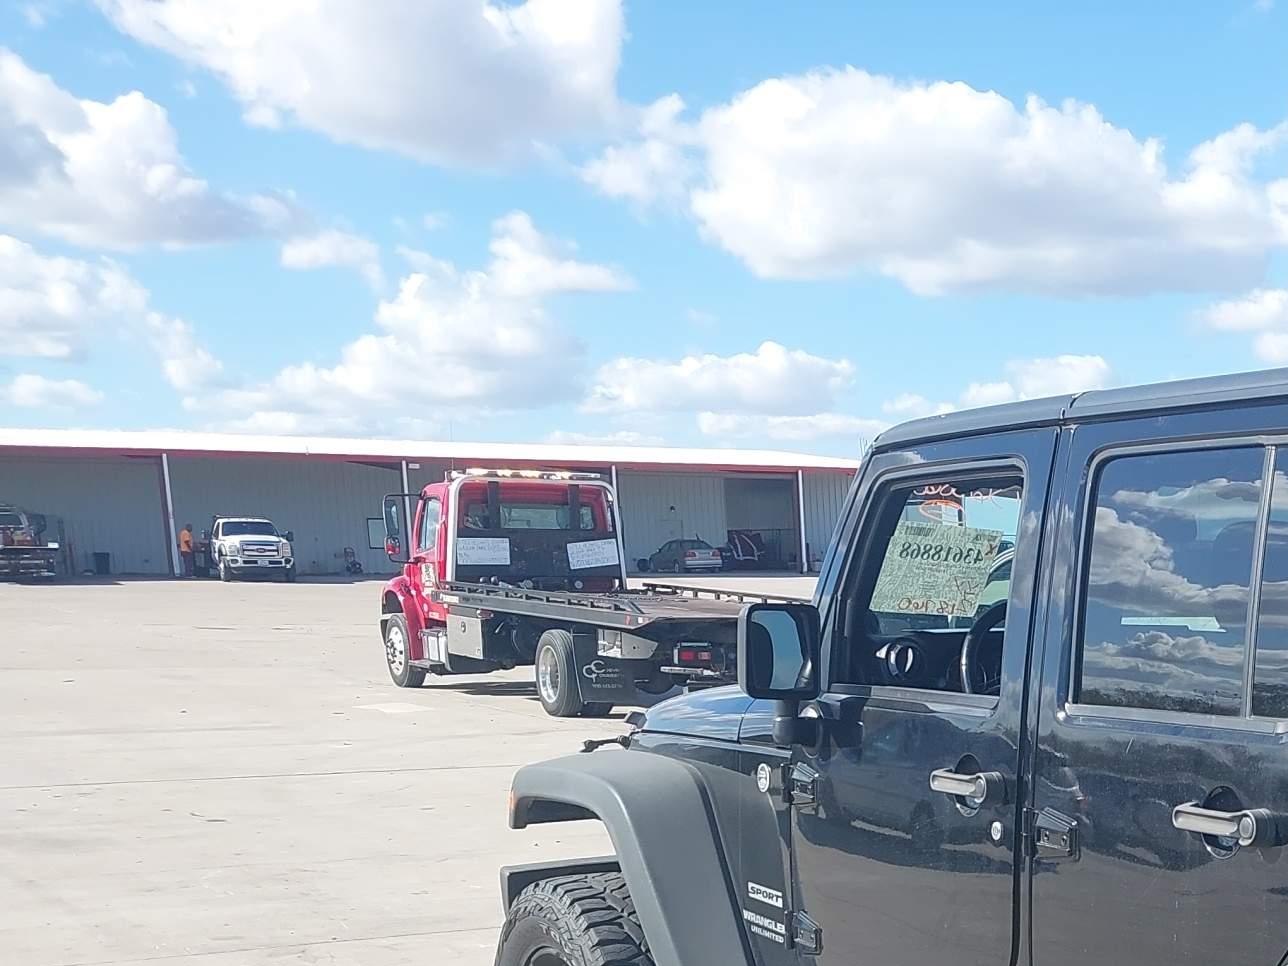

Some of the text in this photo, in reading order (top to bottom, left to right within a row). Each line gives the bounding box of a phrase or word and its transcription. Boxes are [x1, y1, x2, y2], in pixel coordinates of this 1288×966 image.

[748, 885, 784, 904] SPORT
[742, 908, 786, 935] WRANGLE
[750, 923, 785, 944] UNLIMITED
